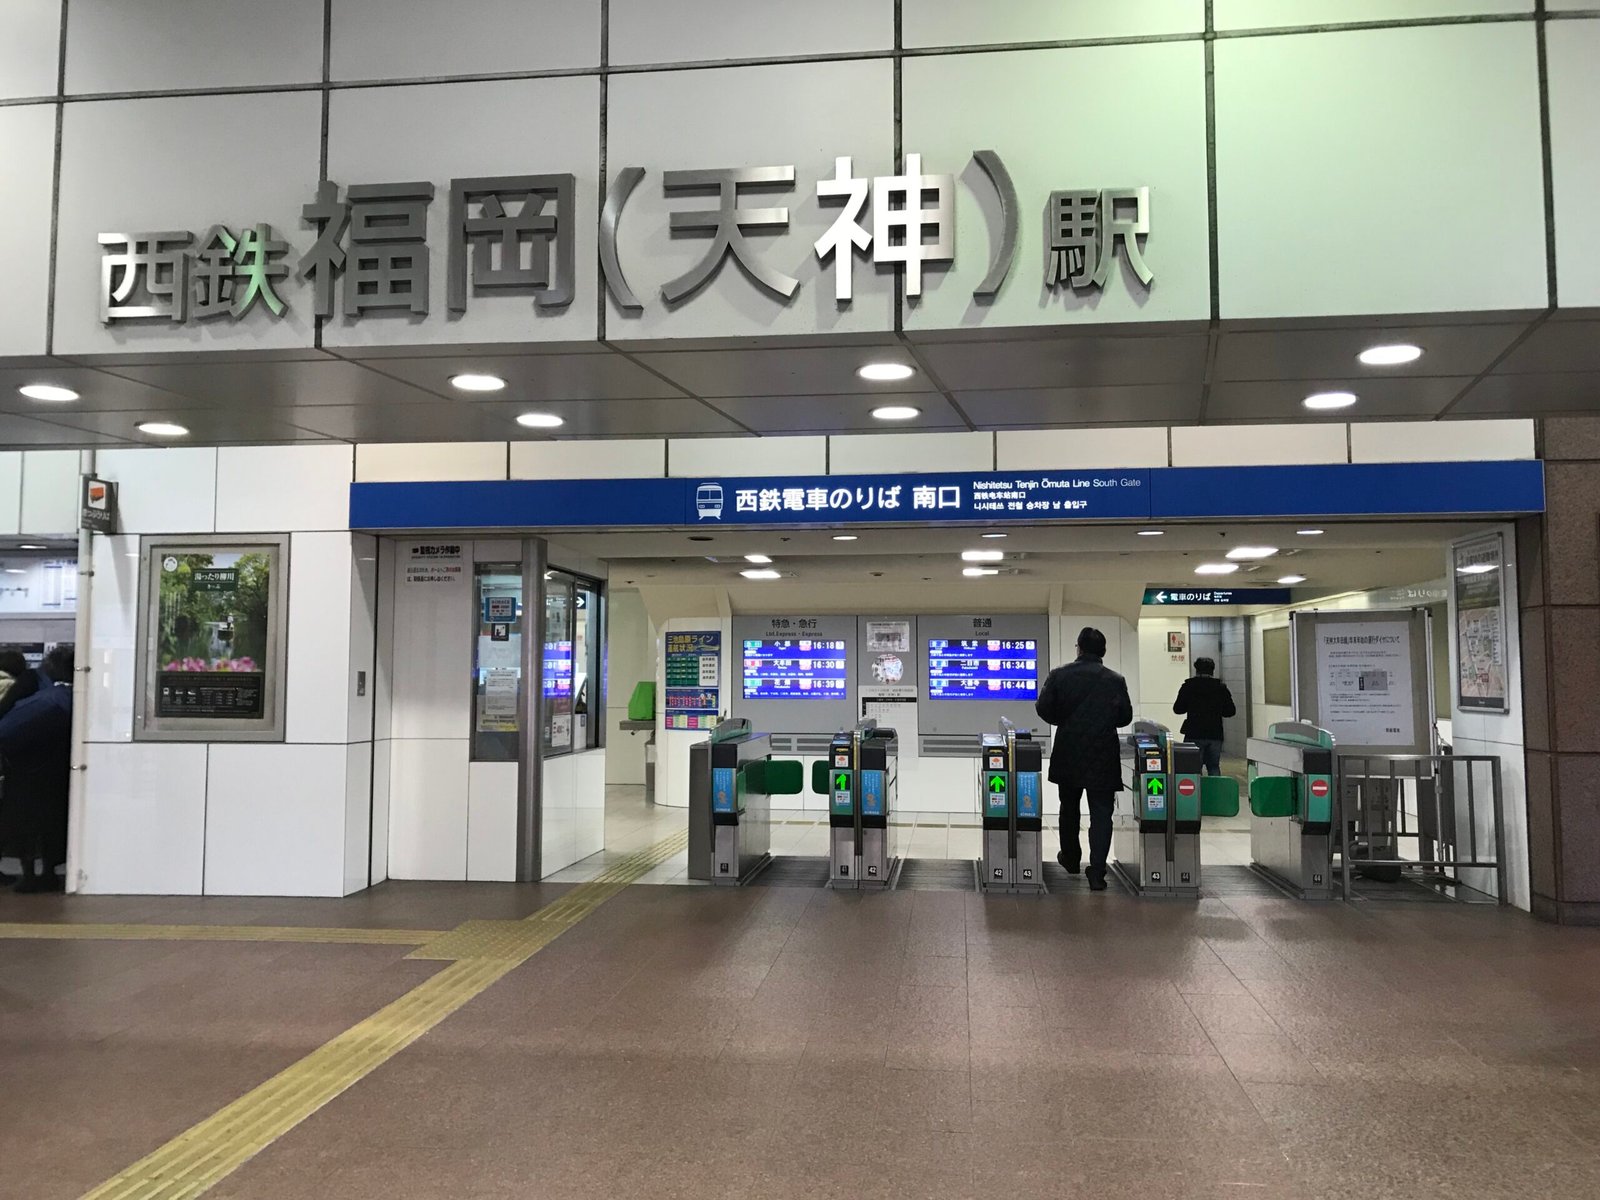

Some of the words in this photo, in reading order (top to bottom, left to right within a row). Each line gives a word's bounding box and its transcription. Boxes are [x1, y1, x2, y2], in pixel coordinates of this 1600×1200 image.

[973, 481, 1012, 490] Nishitetsu
[1015, 480, 1039, 490] Tenjin
[1041, 478, 1070, 488] Ōmuta
[1072, 479, 1090, 488] Line
[1092, 479, 1118, 487] South
[1120, 479, 1141, 487] Gate
[735, 486, 902, 512] 西鉄電車のりば
[913, 486, 961, 509] 南口
[1170, 592, 1212, 601] 電車のりば
[813, 641, 835, 650] 16:18
[1002, 641, 1025, 650] 16:25
[813, 661, 835, 669] 16:30
[1002, 661, 1025, 669] 16:34
[813, 680, 835, 689] 16:39
[1002, 681, 1026, 690] 16:44
[868, 866, 877, 874] 42
[994, 869, 1003, 877] 42
[1152, 872, 1160, 880] 43
